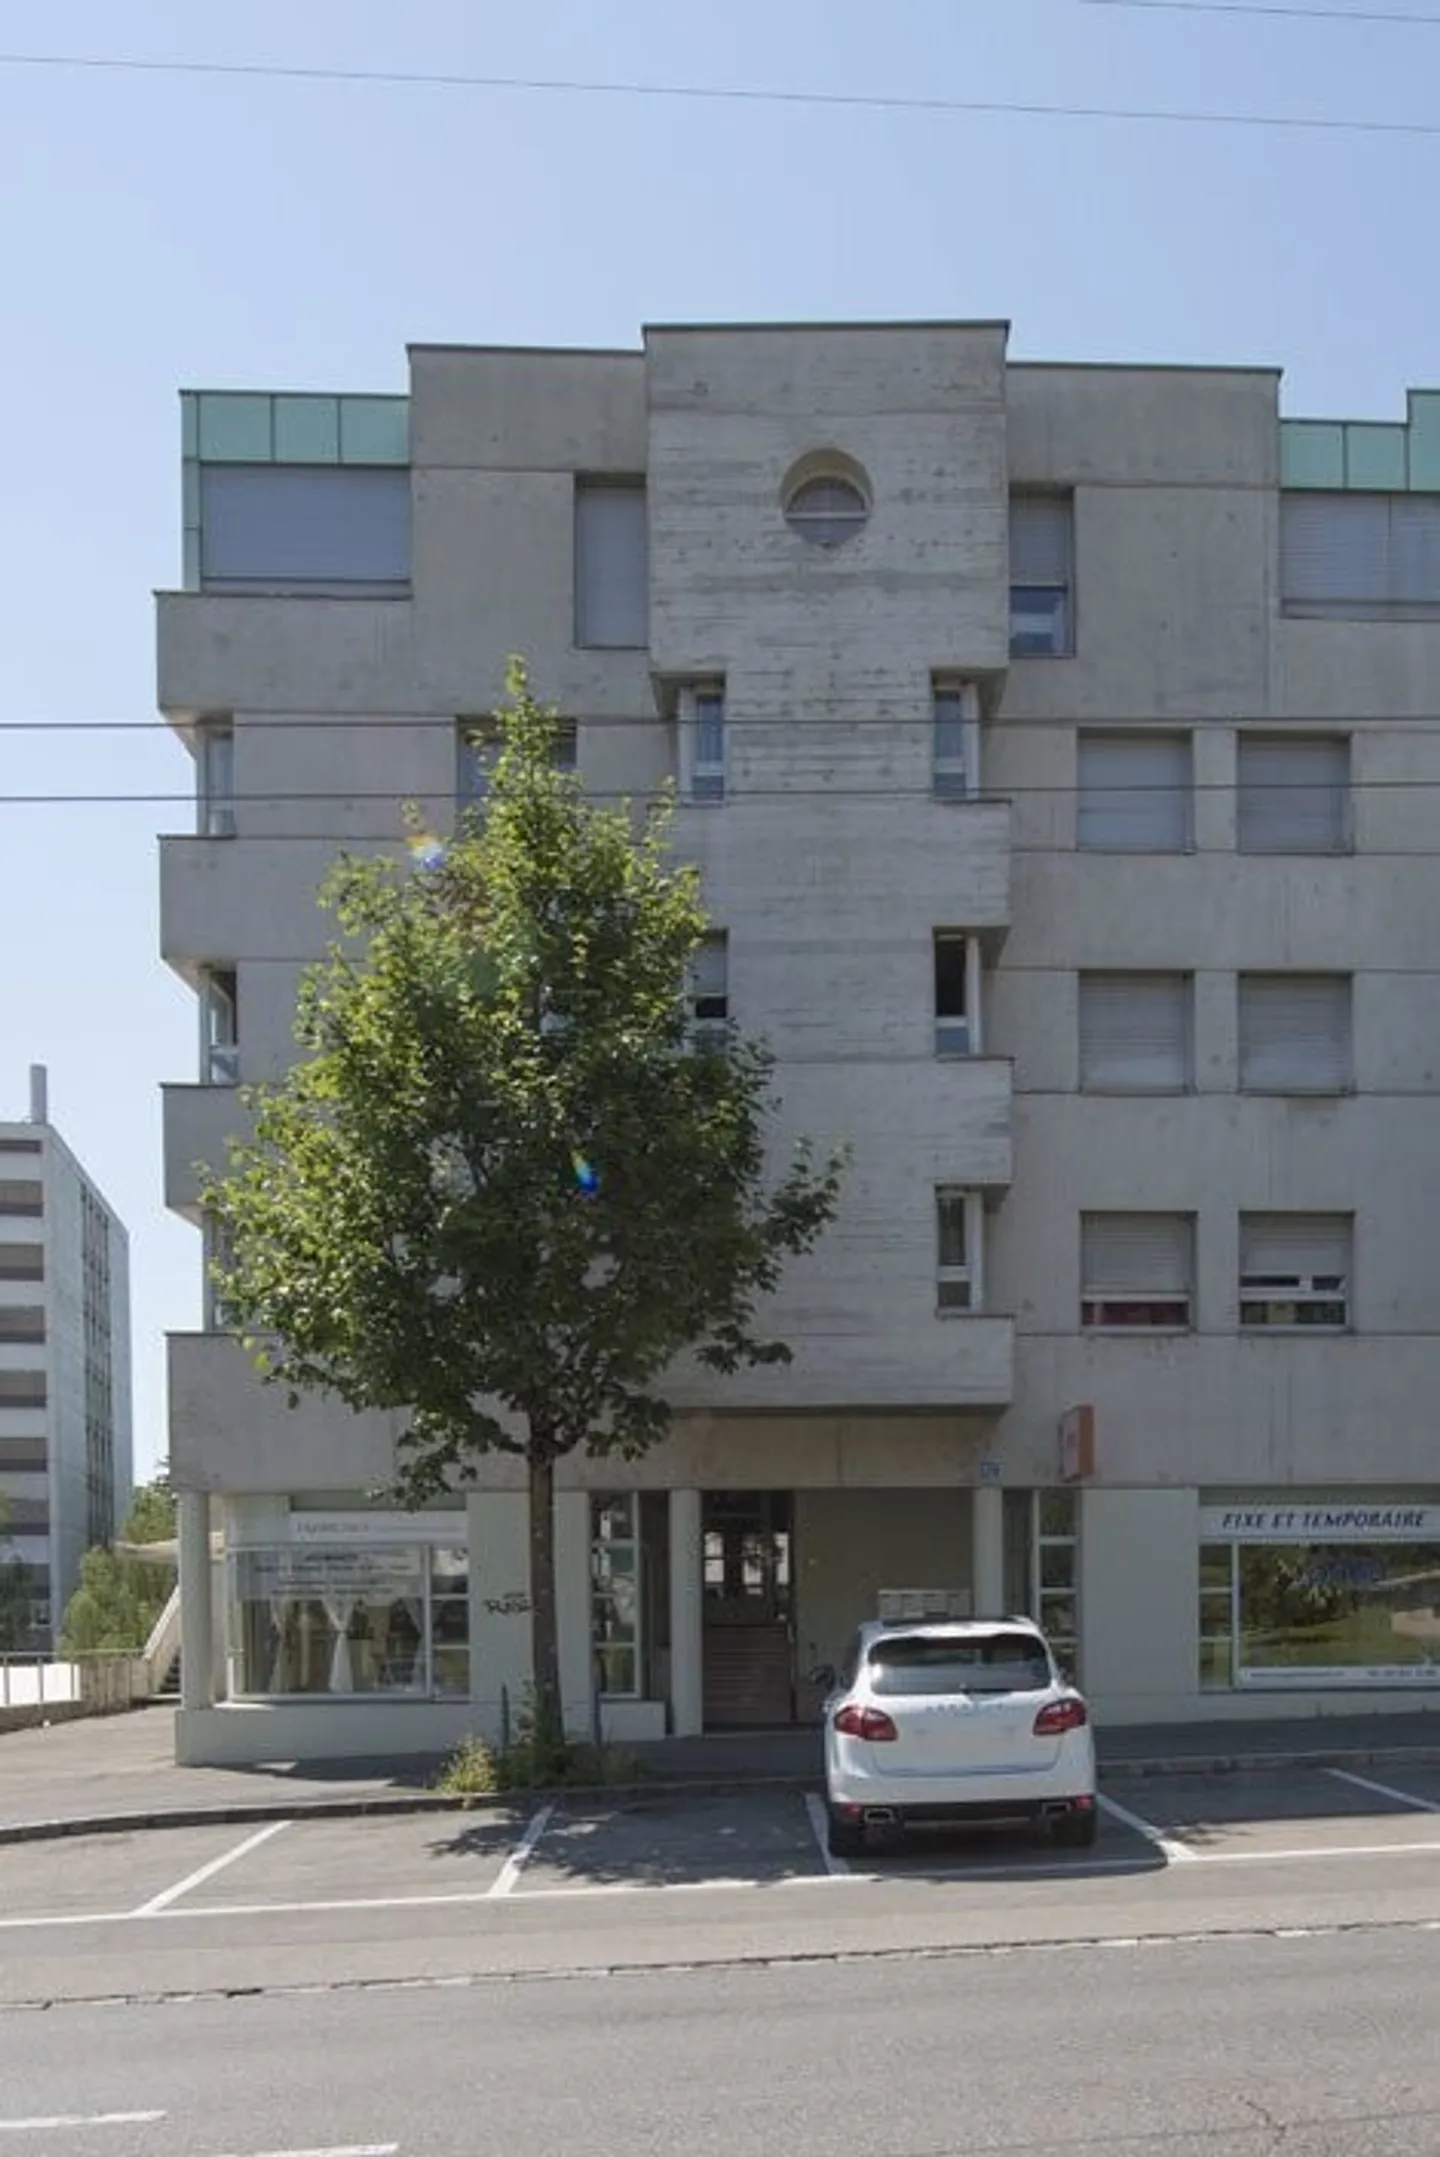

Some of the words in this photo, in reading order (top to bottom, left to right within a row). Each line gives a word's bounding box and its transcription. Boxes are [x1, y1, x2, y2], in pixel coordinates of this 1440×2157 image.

[1222, 1513, 1265, 1529] FIXE
[1271, 1512, 1296, 1528] ET
[1303, 1511, 1426, 1527] TEMPORAIRE
